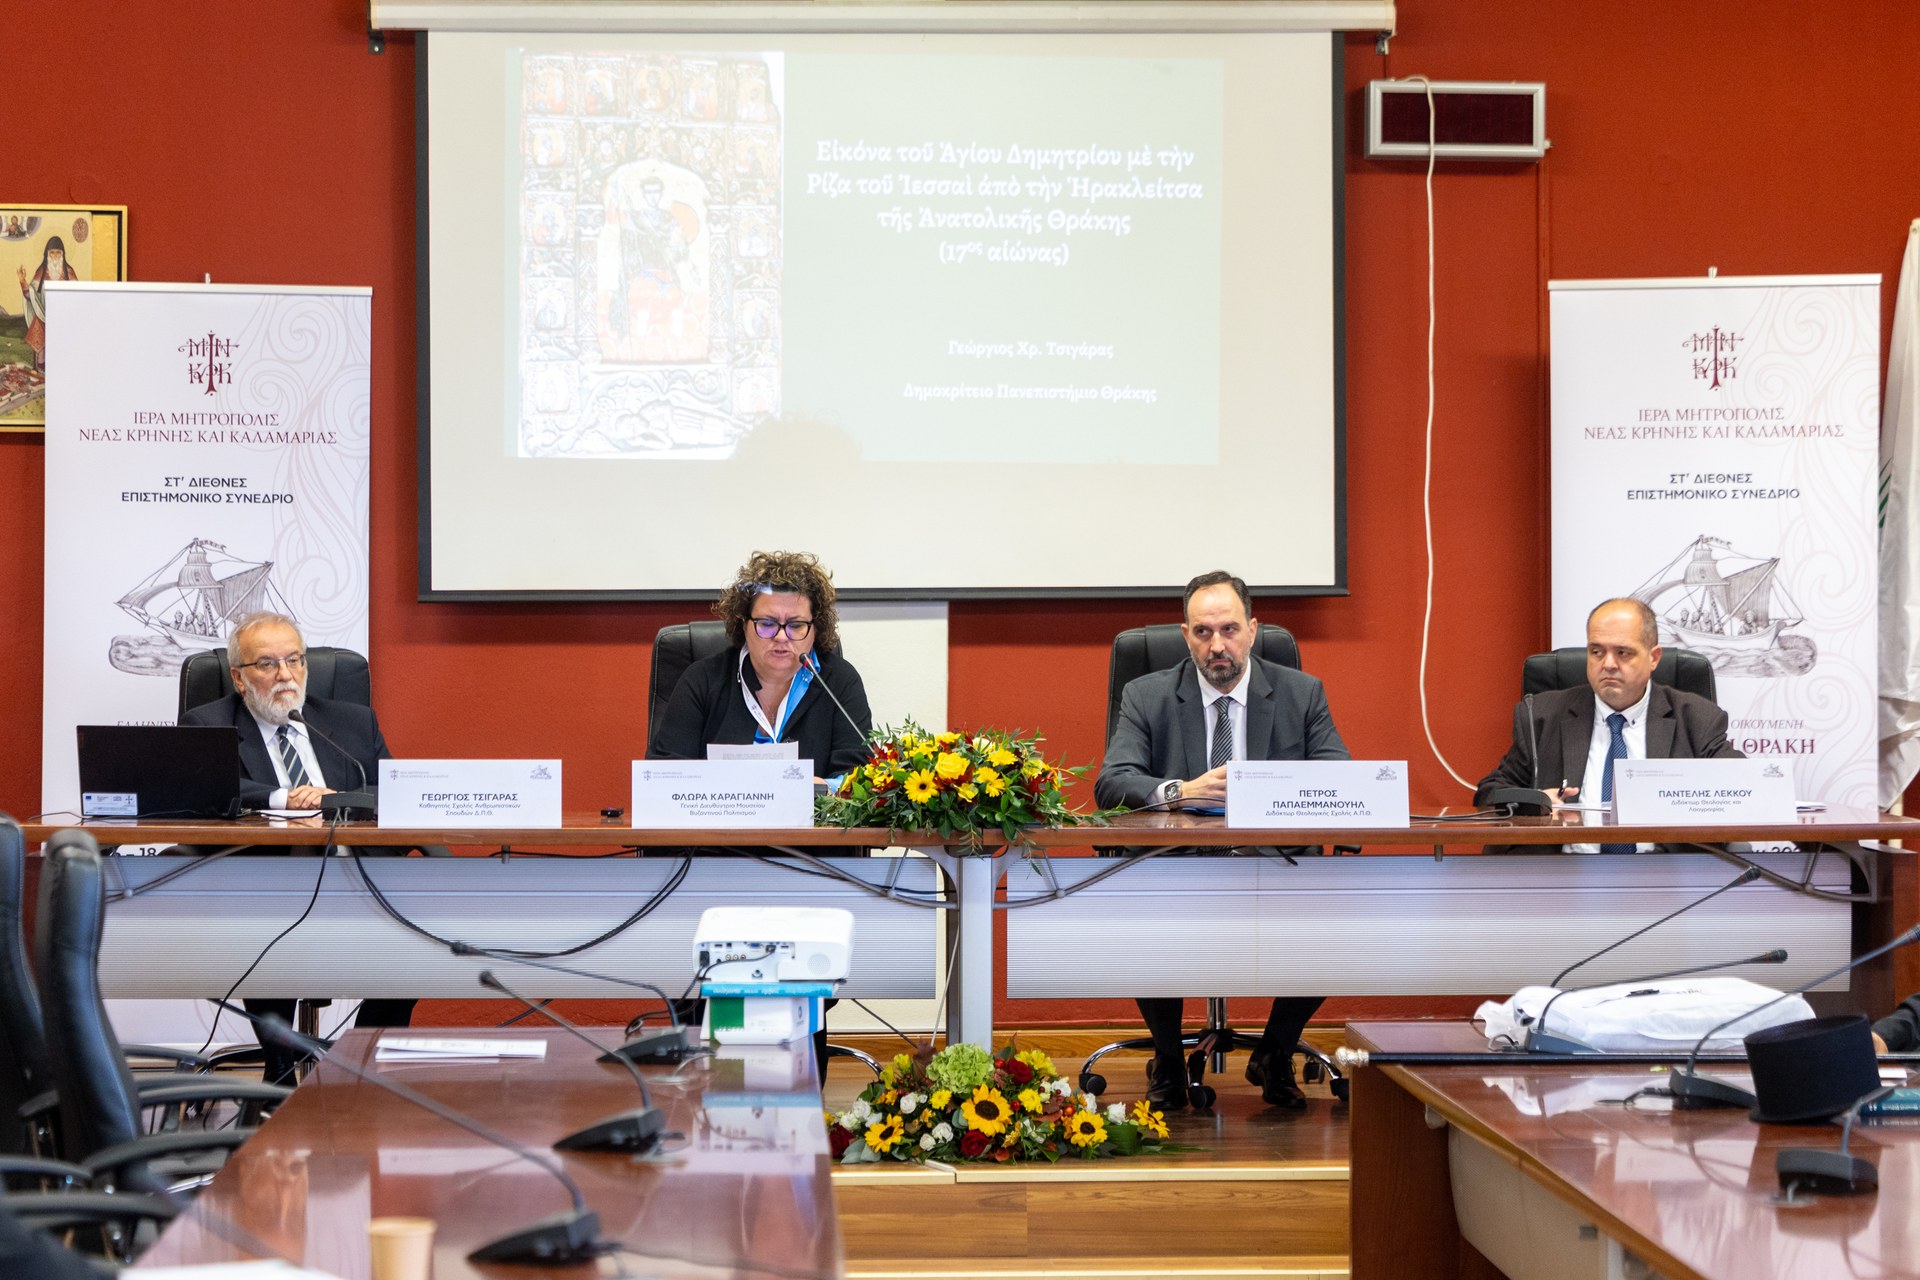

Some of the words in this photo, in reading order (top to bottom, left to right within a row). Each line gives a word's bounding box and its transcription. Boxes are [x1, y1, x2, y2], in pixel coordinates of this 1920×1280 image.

[1006, 143, 1121, 170] Δημητρίου
[1127, 144, 1153, 170] μὲ
[806, 172, 852, 198] Ρίζα
[1047, 208, 1132, 236] Θράκης
[947, 340, 1014, 359] Γεώργιος
[1016, 341, 1043, 359] Χρ.
[1046, 341, 1115, 360] Τσιγάρας
[903, 383, 994, 402] Δημοκρίτειο
[997, 384, 1099, 403] Πανεπιστήμιο
[1101, 384, 1158, 404] Θράκης
[134, 411, 166, 425] ΙΕΡΑ
[171, 412, 280, 426] ΜΗΤΡΟΠΟΛΙΣ
[1638, 408, 1671, 422] ΙΕΡΑ
[1675, 407, 1785, 422] ΜΗΤΡΟΠΟΛΙΣ
[79, 428, 122, 442] ΝΕΑΣ
[126, 429, 193, 443] ΚΡΗΝΗΣ
[198, 430, 224, 443] ΚΑΙ
[230, 430, 337, 444] ΚΑΛΑΜΑΡΙΑΣ
[1584, 426, 1627, 440] ΝΕΑΣ
[1631, 425, 1698, 440] ΚΡΗΝΗΣ
[1702, 425, 1730, 439] ΚΑΙ
[1735, 424, 1845, 439] ΚΑΛΑΜΑΡΙΑΣ
[188, 477, 248, 488] ΔΙΕΘΝΕΣ
[1693, 473, 1753, 485] ΔΙΕΘΝΕΣ
[121, 491, 223, 504] ΕΠΙΣΤΗΜΟΝΙΚΟ
[225, 493, 294, 504] ΣΥΝΕΔΡΙΟ
[1627, 489, 1728, 501] ΕΠΙΣΤΗΜΟΝΙΚΟ
[1731, 488, 1801, 500] ΣΥΝΕΔΡΙΟ
[1730, 719, 1804, 730] ΟΙΚΟΥΜΕΝΗ
[1742, 738, 1816, 755] ΘΡΑΚΗ
[421, 793, 470, 802] ΓΕΩΡΓΙΟΣ
[472, 793, 519, 802] ΤΣΙΓΑΡΑΣ
[671, 792, 708, 801] ΦΛΩΡΑ
[710, 792, 775, 801] ΚΑΡΑΓΙΑΝΝΗ
[1299, 789, 1338, 798] ΠΕΤΡΟΣ
[1658, 789, 1711, 798] ΠΑΝΤΕΛΗΣ
[1713, 789, 1753, 798] ΛΕΚΚΟΥ
[1272, 800, 1366, 809] ΠΑΠΑΕΜΜΑΝΟΥΗΛ
